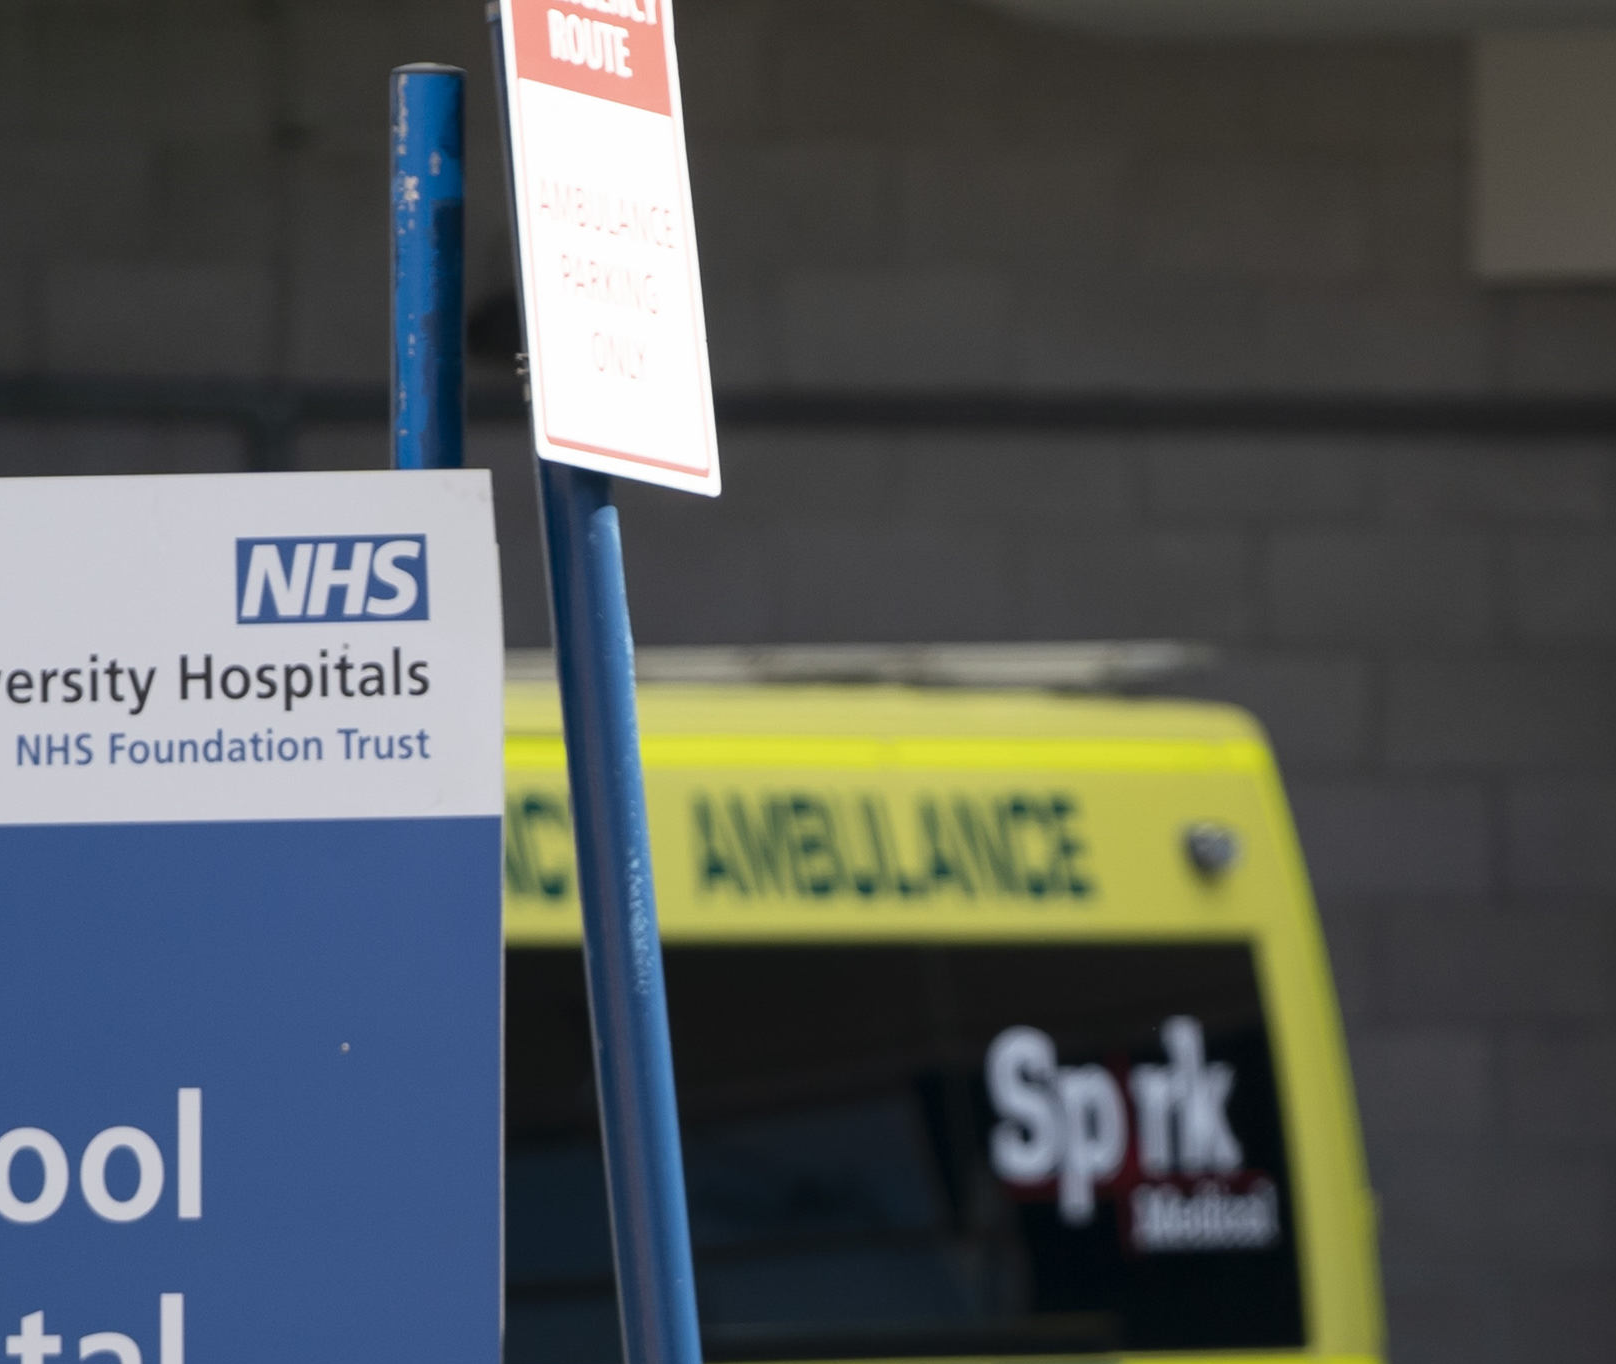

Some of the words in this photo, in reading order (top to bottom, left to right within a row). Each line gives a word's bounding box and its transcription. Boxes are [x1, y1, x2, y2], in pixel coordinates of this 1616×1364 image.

[546, 8, 633, 78] ROUTE
[539, 177, 678, 250] AMBULANCE
[561, 253, 660, 316] PARKING
[591, 331, 648, 381] ONLY
[240, 539, 421, 618] NHS
[179, 647, 431, 712] Hospitals
[16, 733, 95, 767] NHS
[109, 728, 323, 765] Foundation
[337, 728, 430, 760] Trust
[691, 791, 1098, 902] AMBULANCE
[985, 1014, 1245, 1227] Sprk
